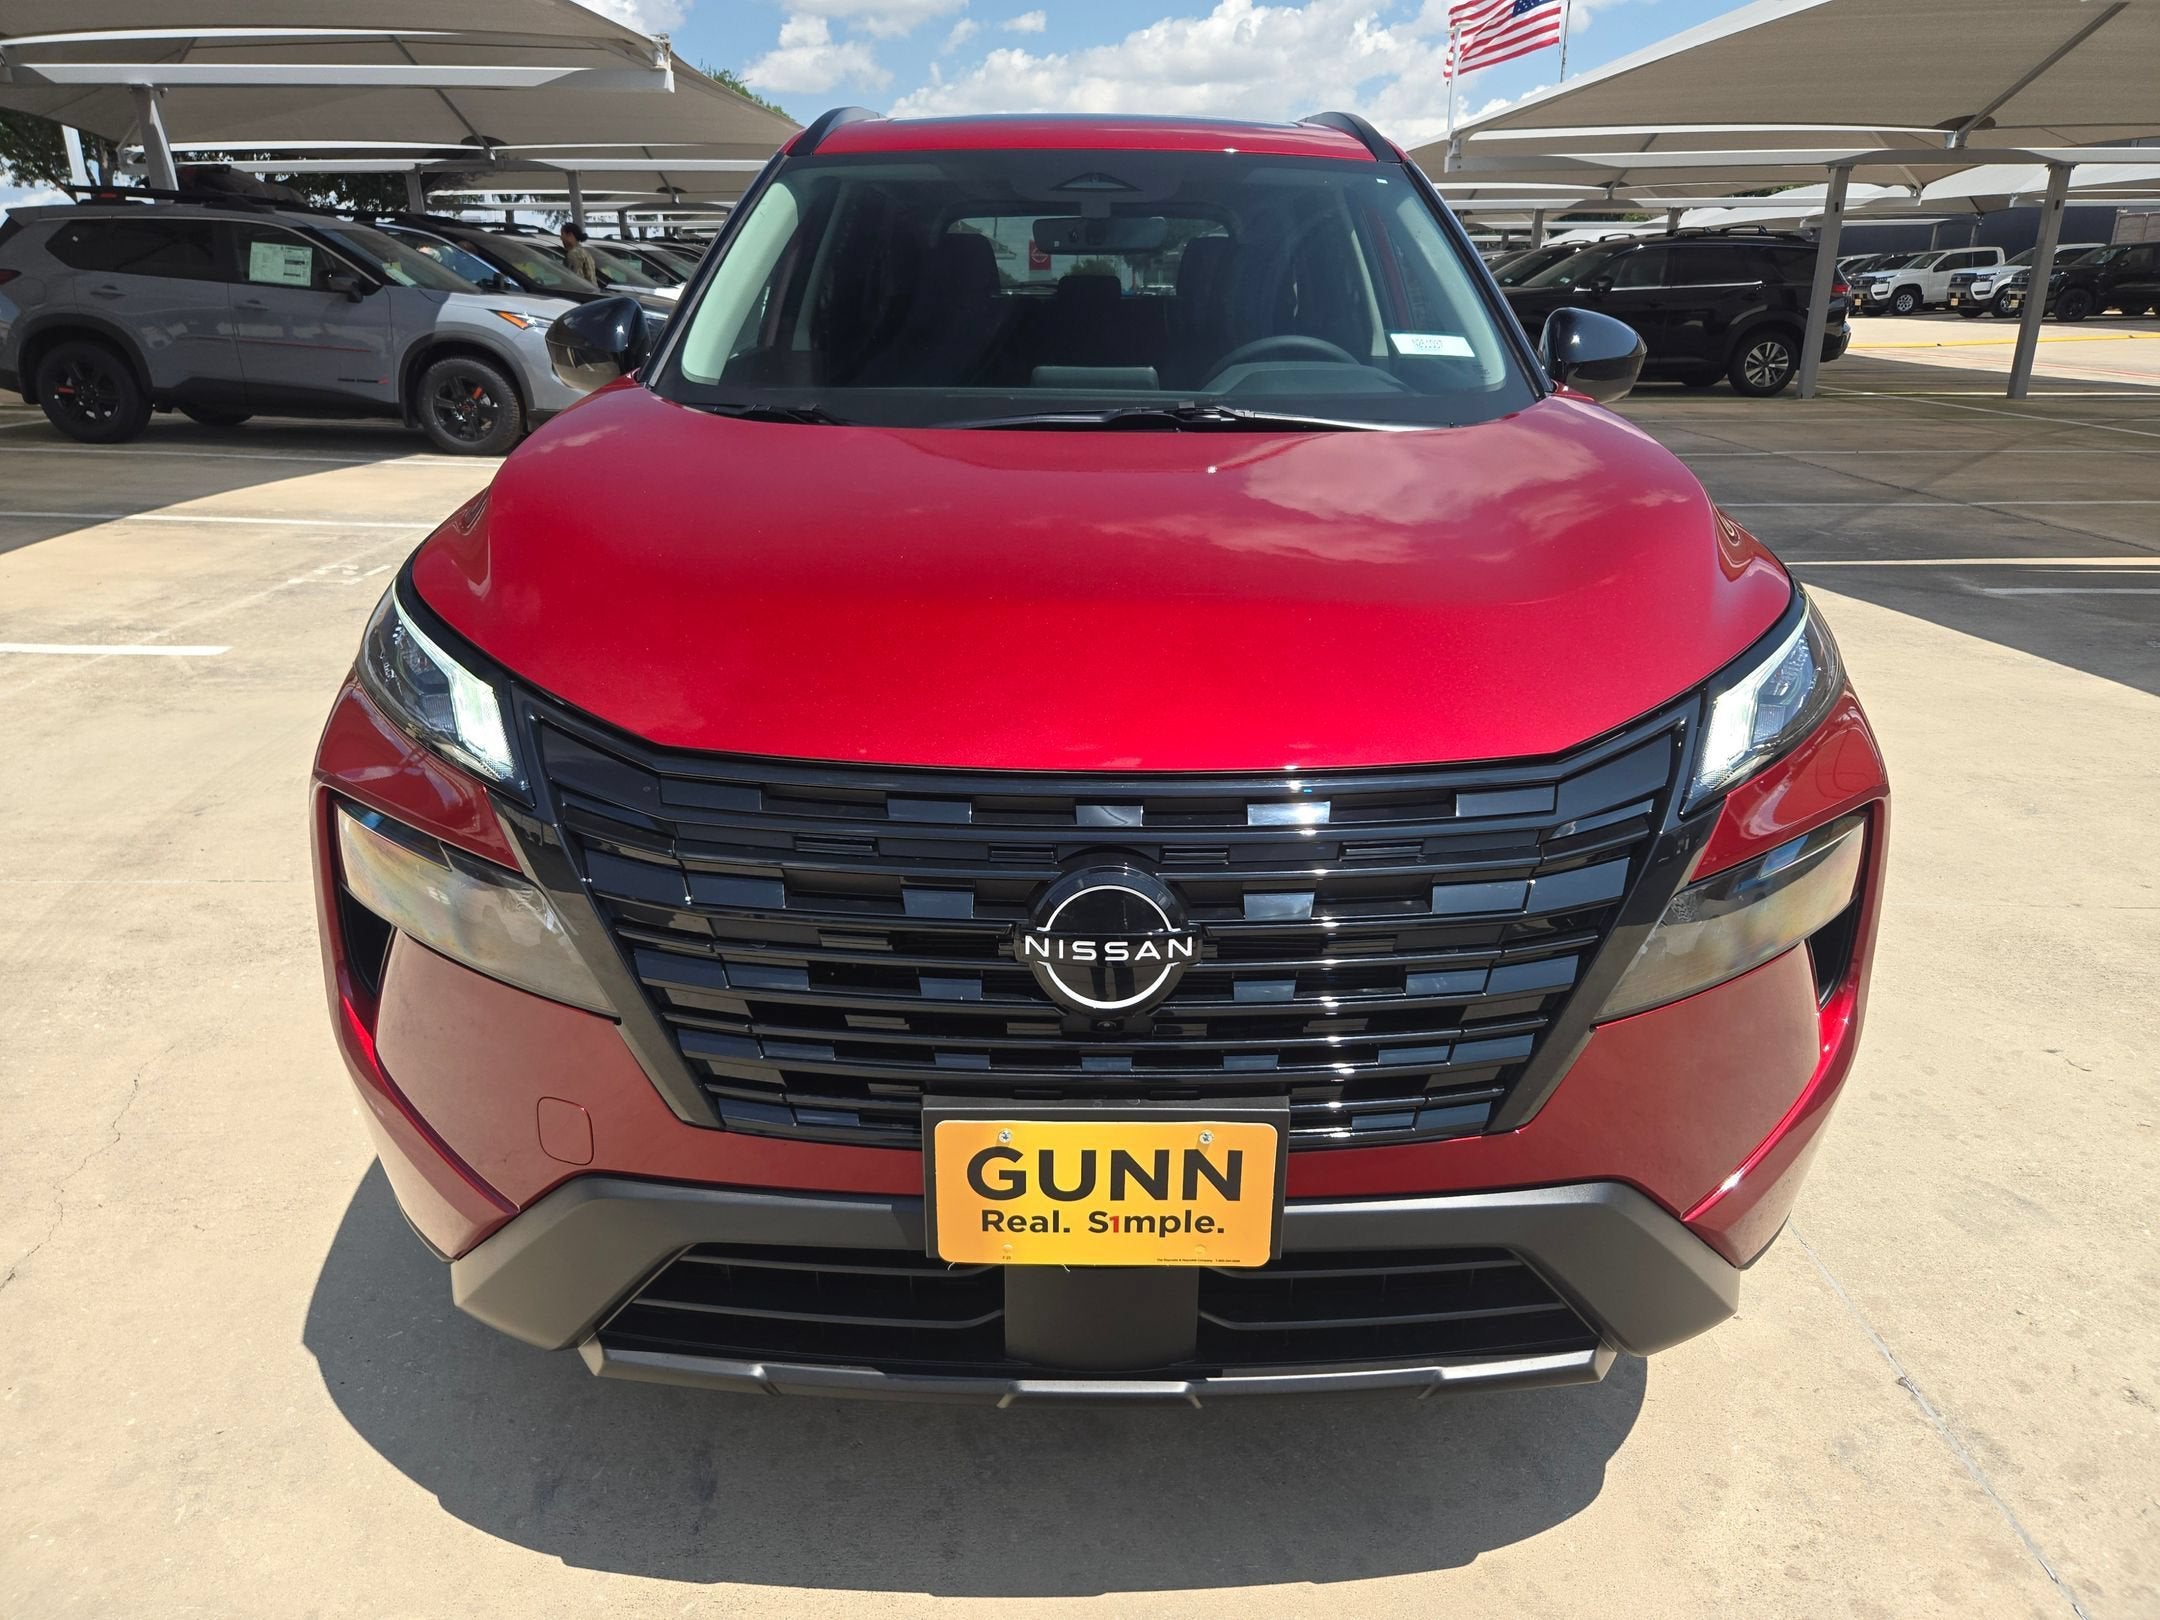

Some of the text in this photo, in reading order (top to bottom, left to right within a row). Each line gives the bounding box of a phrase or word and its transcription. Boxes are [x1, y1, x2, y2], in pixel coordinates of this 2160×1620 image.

[1024, 935, 1193, 961] NISSAN
[967, 1146, 1244, 1202] GUNN
[981, 1210, 1225, 1238] Real. S1mple.
